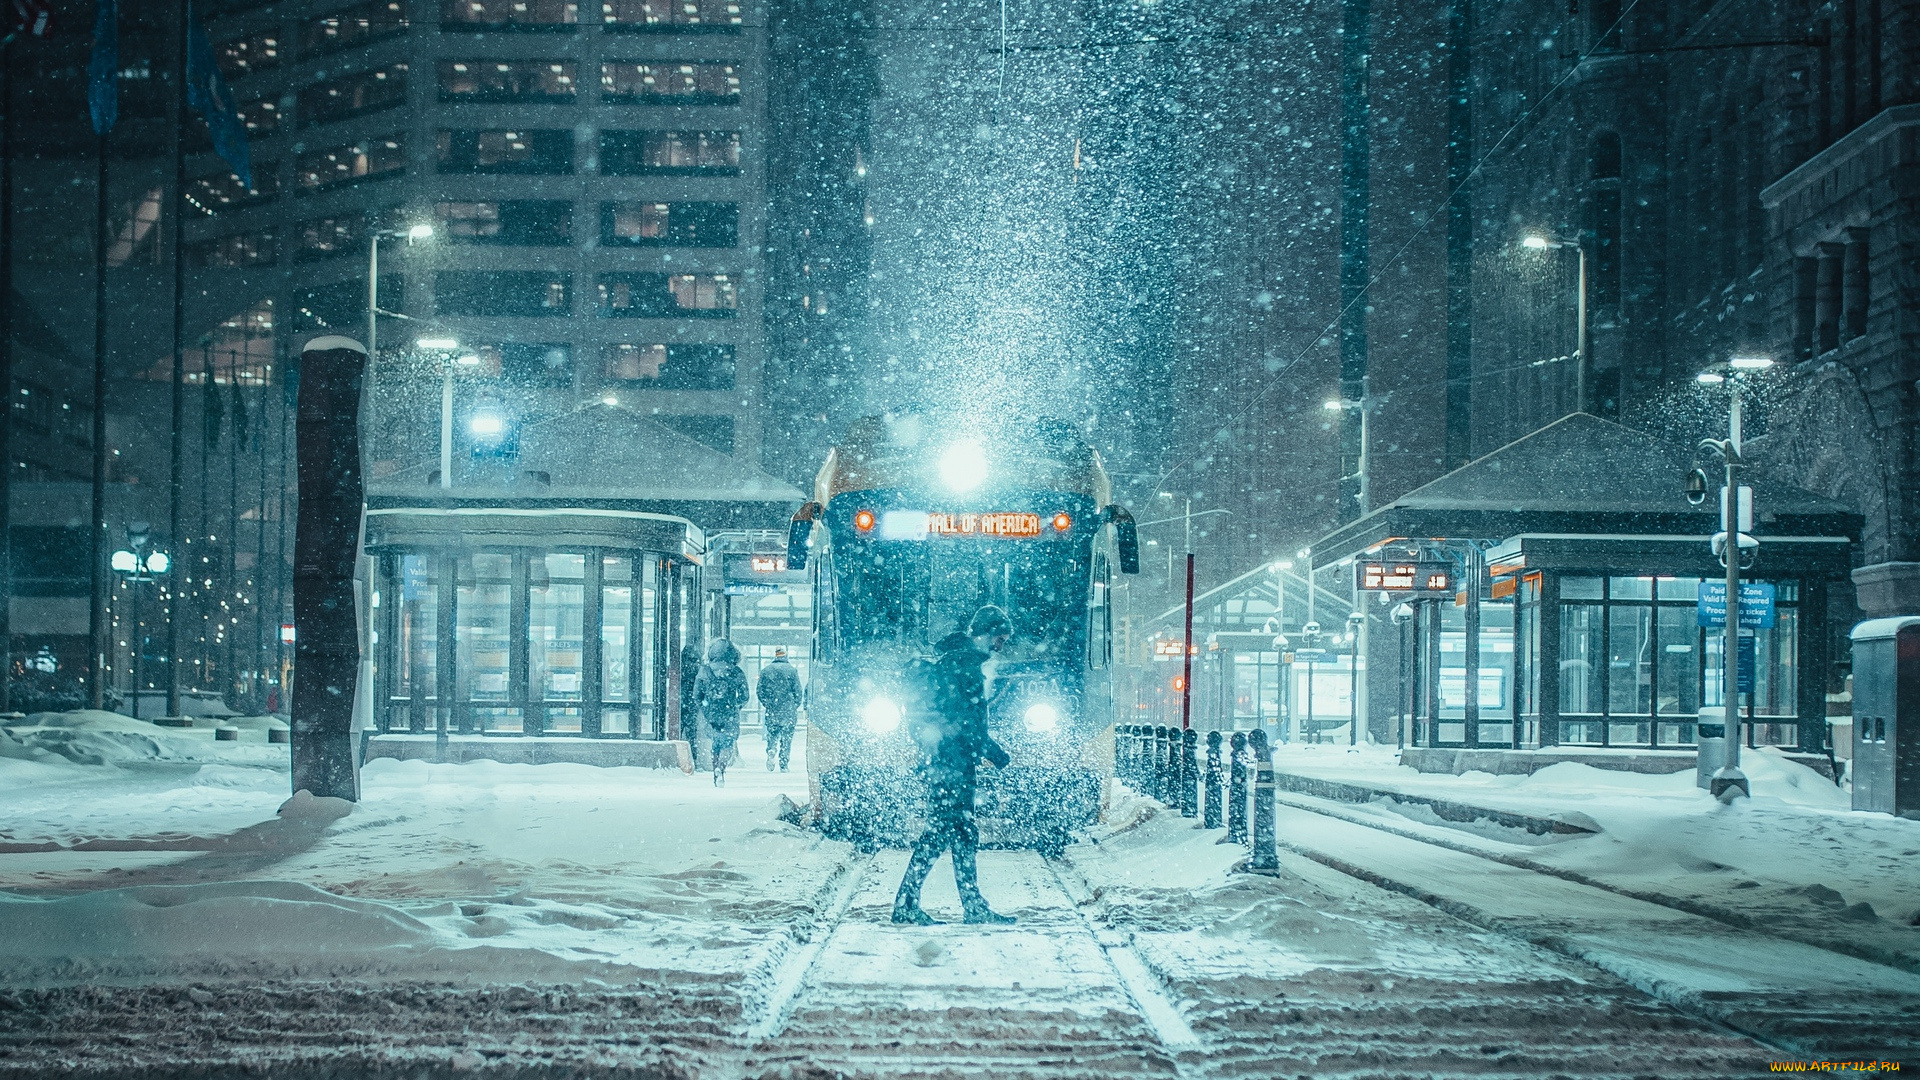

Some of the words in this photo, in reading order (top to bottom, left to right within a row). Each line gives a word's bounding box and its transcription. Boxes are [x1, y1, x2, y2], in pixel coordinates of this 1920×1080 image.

[929, 514, 957, 533] MALL
[962, 514, 977, 533] OF
[981, 513, 1038, 534] AMERICA
[741, 585, 773, 594] TICKETS
[1710, 586, 1725, 595] Paid
[1743, 587, 1763, 596] Zone
[1703, 594, 1720, 603] Valid
[1738, 596, 1770, 606] Required
[1706, 606, 1726, 614] Proce
[1746, 608, 1767, 616] ticket
[1740, 617, 1762, 625] ahead
